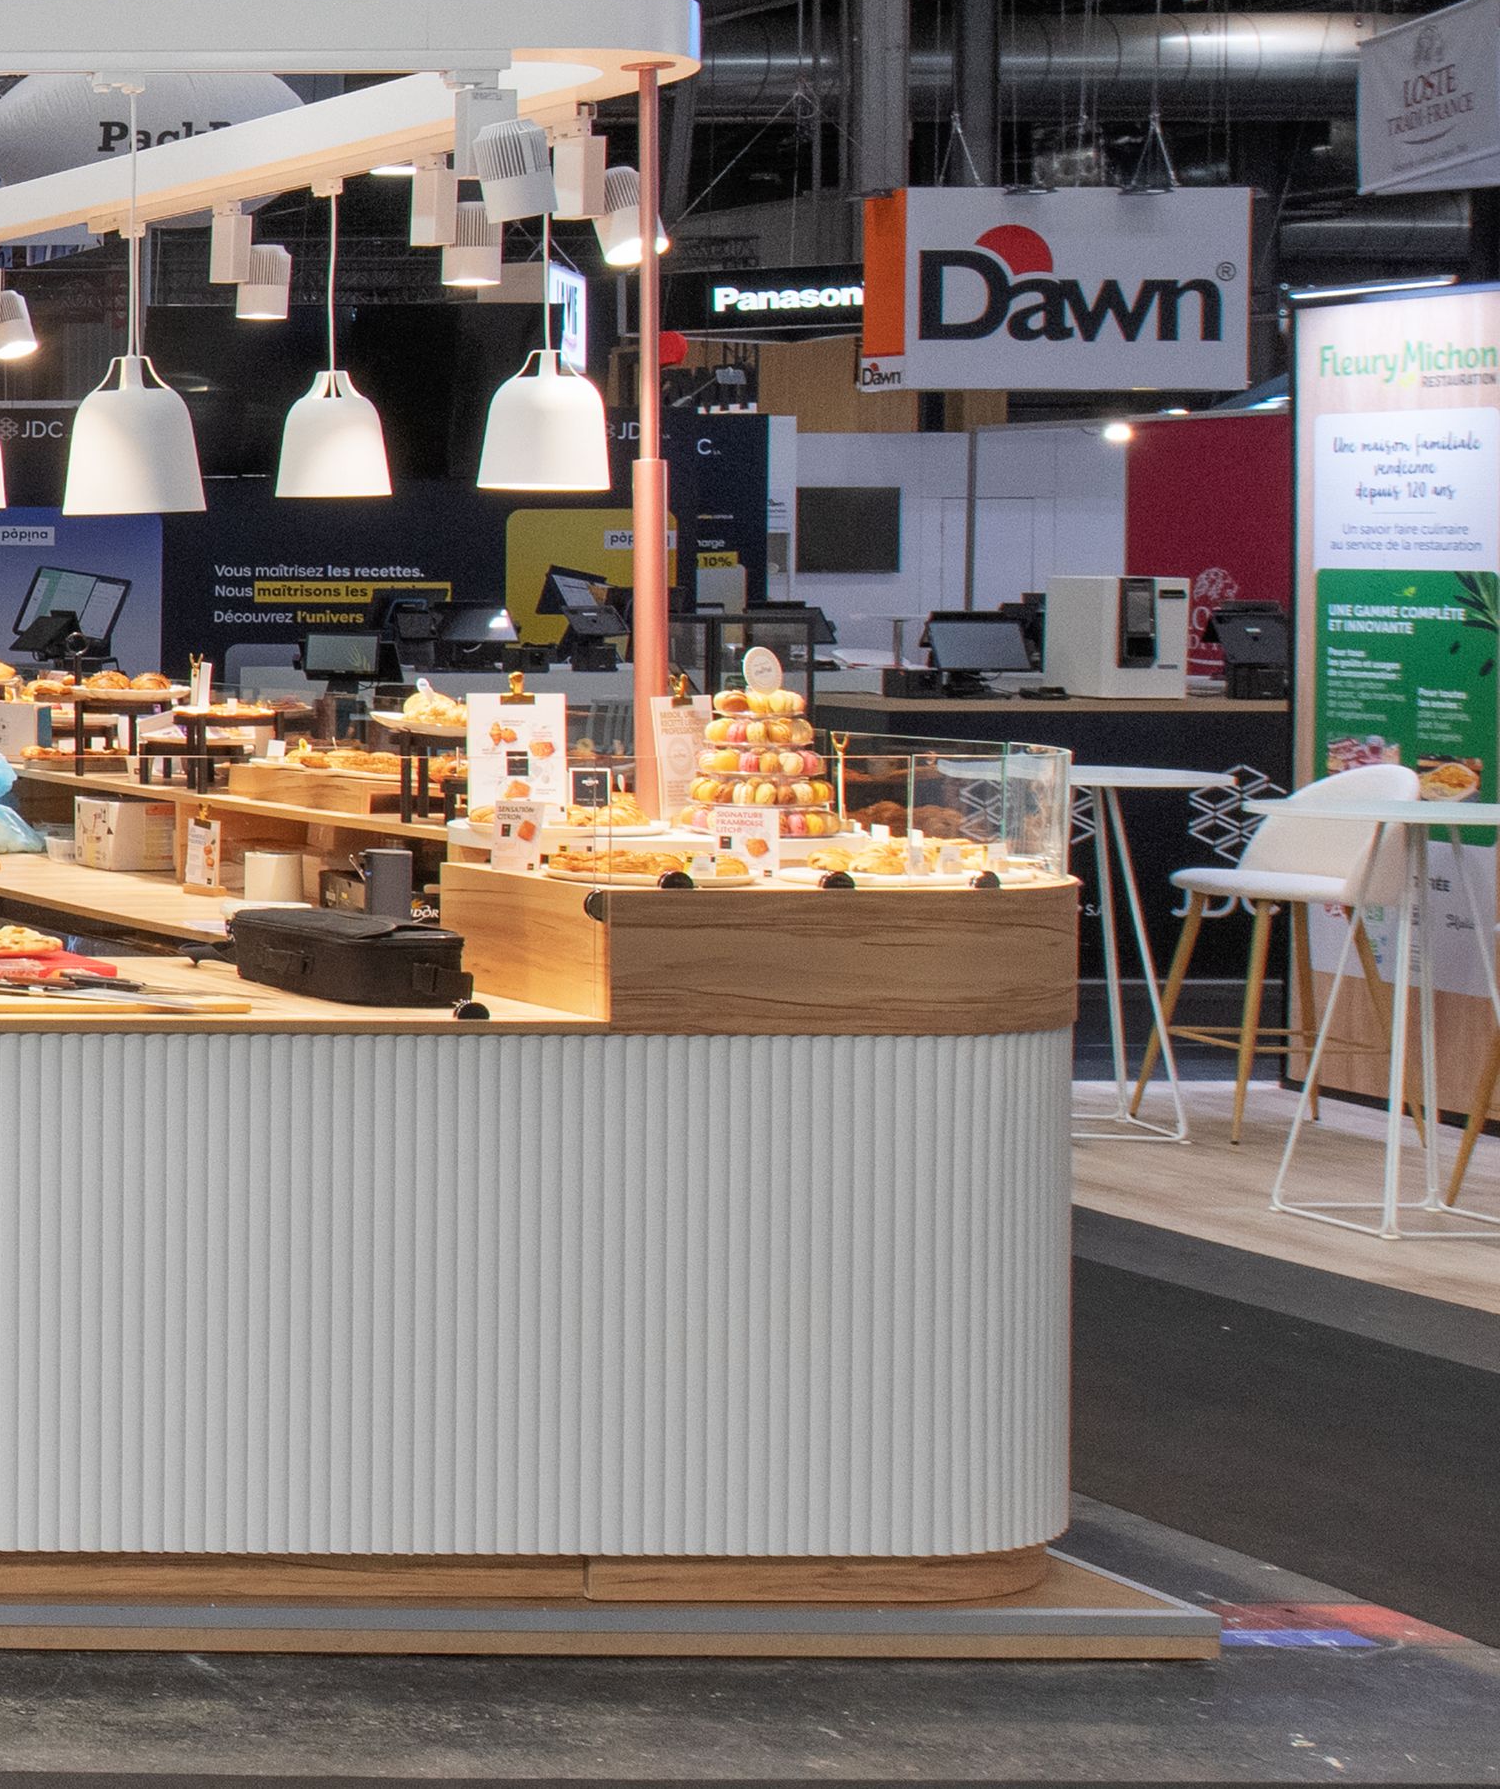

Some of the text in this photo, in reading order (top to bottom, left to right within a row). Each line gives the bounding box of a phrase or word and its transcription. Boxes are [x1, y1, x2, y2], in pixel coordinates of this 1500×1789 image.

[1403, 64, 1456, 108] LOSTE
[713, 284, 865, 312] Panason
[919, 248, 1223, 342] Dawn
[1319, 345, 1398, 384] Fleury
[1402, 341, 1498, 373] Michon
[862, 367, 902, 386] Dawn
[1421, 372, 1497, 388] RESTAURATION
[21, 421, 64, 439] JDC
[1406, 481, 1427, 499] 120
[1360, 522, 1392, 536] savoir
[1393, 522, 1418, 536] faire
[1420, 522, 1469, 536] culinaire
[1347, 540, 1385, 551] service
[1387, 539, 1399, 551] de
[1401, 539, 1411, 551] la
[1413, 539, 1482, 552] restauration
[214, 564, 425, 578] Vous maîtrisez les recettes.
[703, 556, 733, 568] 10%
[214, 585, 253, 598] Nous
[257, 584, 341, 598] maîtrisons
[345, 584, 368, 598] les
[214, 610, 293, 624] Découvrez
[1328, 603, 1467, 621] UNE GAMME COMPLÈTE
[1328, 619, 1415, 635] ET INNOVANTE
